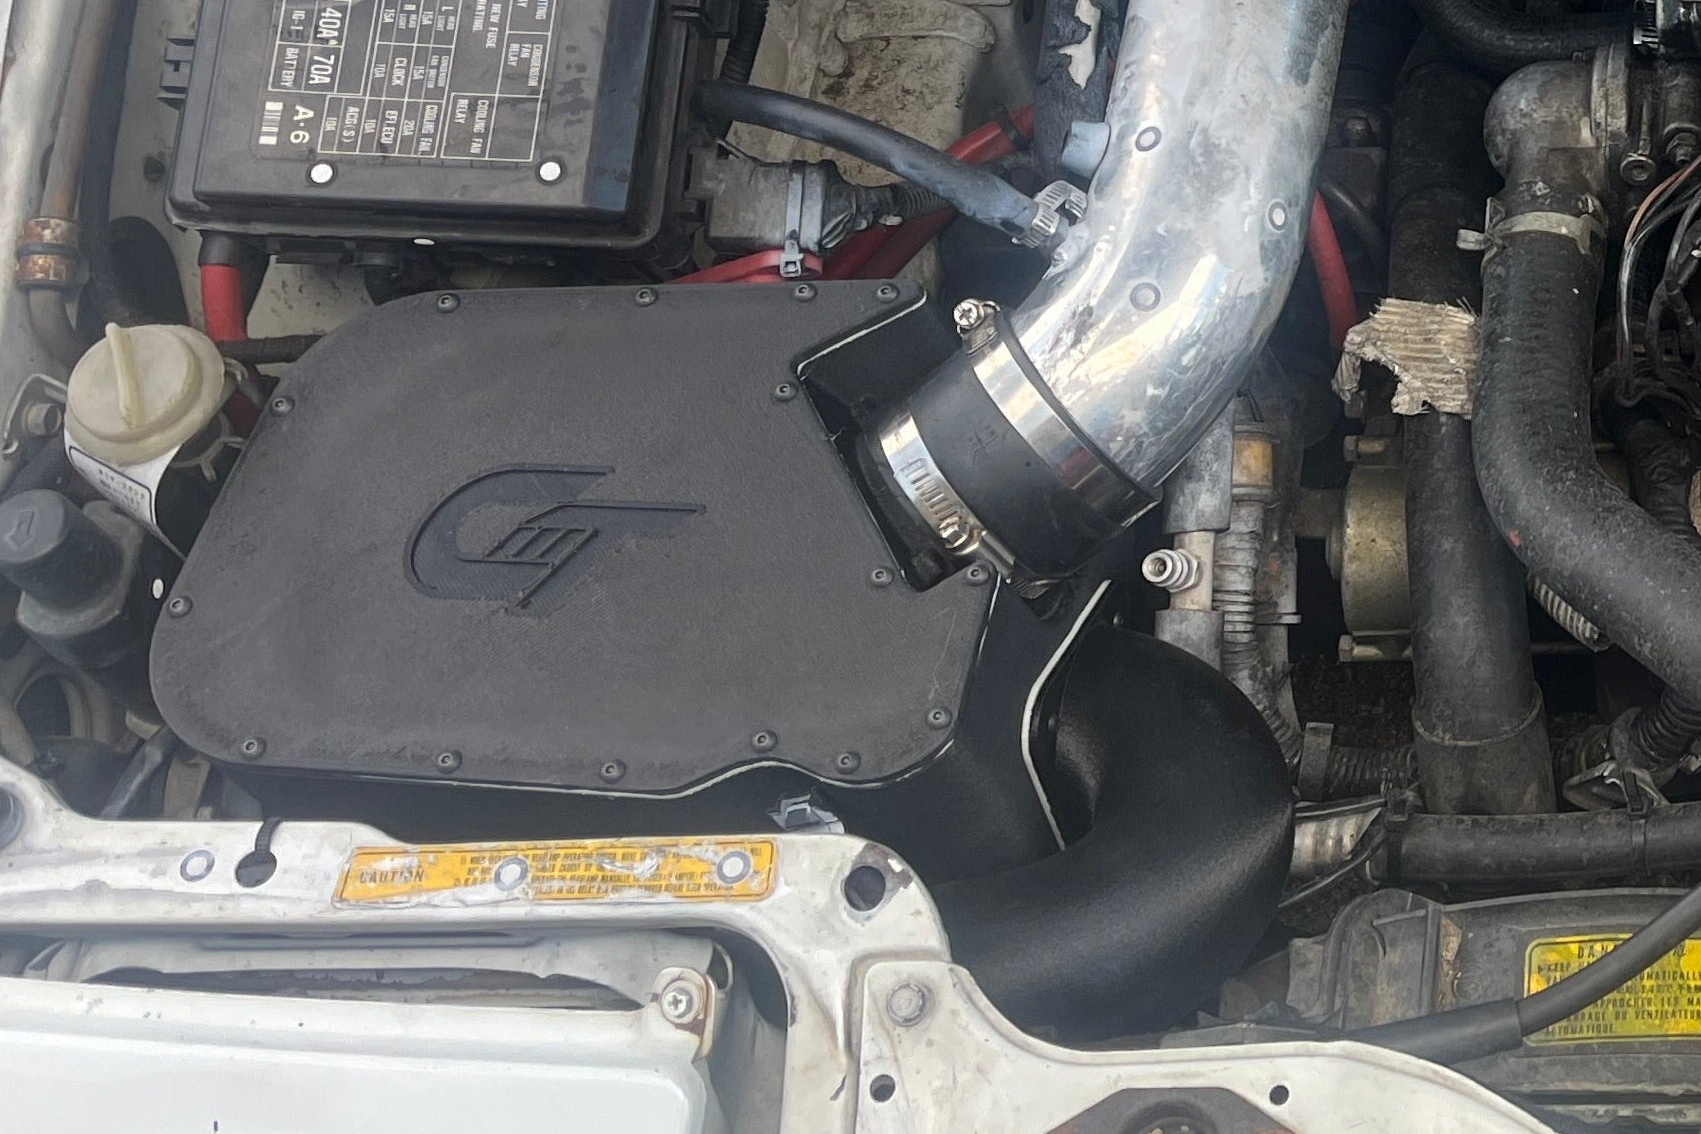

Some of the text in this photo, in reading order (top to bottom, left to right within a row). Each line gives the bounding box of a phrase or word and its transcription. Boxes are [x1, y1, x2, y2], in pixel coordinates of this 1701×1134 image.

[290, 10, 306, 30] IG-1
[316, 7, 343, 38] 40A
[382, 8, 396, 23] 15A
[421, 11, 434, 26] 15A
[489, 3, 502, 23] NEW
[485, 26, 499, 49] FUSE
[507, 43, 521, 67] RELAY
[520, 43, 532, 58] FAN
[280, 47, 300, 88] BATTERY
[308, 54, 335, 85] 70A
[373, 63, 386, 78] 10A
[391, 57, 408, 86] CLOCK
[412, 65, 425, 80] 15A
[421, 104, 439, 134] COOLING
[454, 98, 469, 124] RELAY
[324, 117, 338, 132] 10A
[363, 119, 377, 134] 10A
[401, 119, 416, 136] 20A
[469, 99, 490, 154] COOLING FAN
[360, 869, 424, 885] CAUTION
[1635, 1009, 1701, 1020] VENTILATEUR
